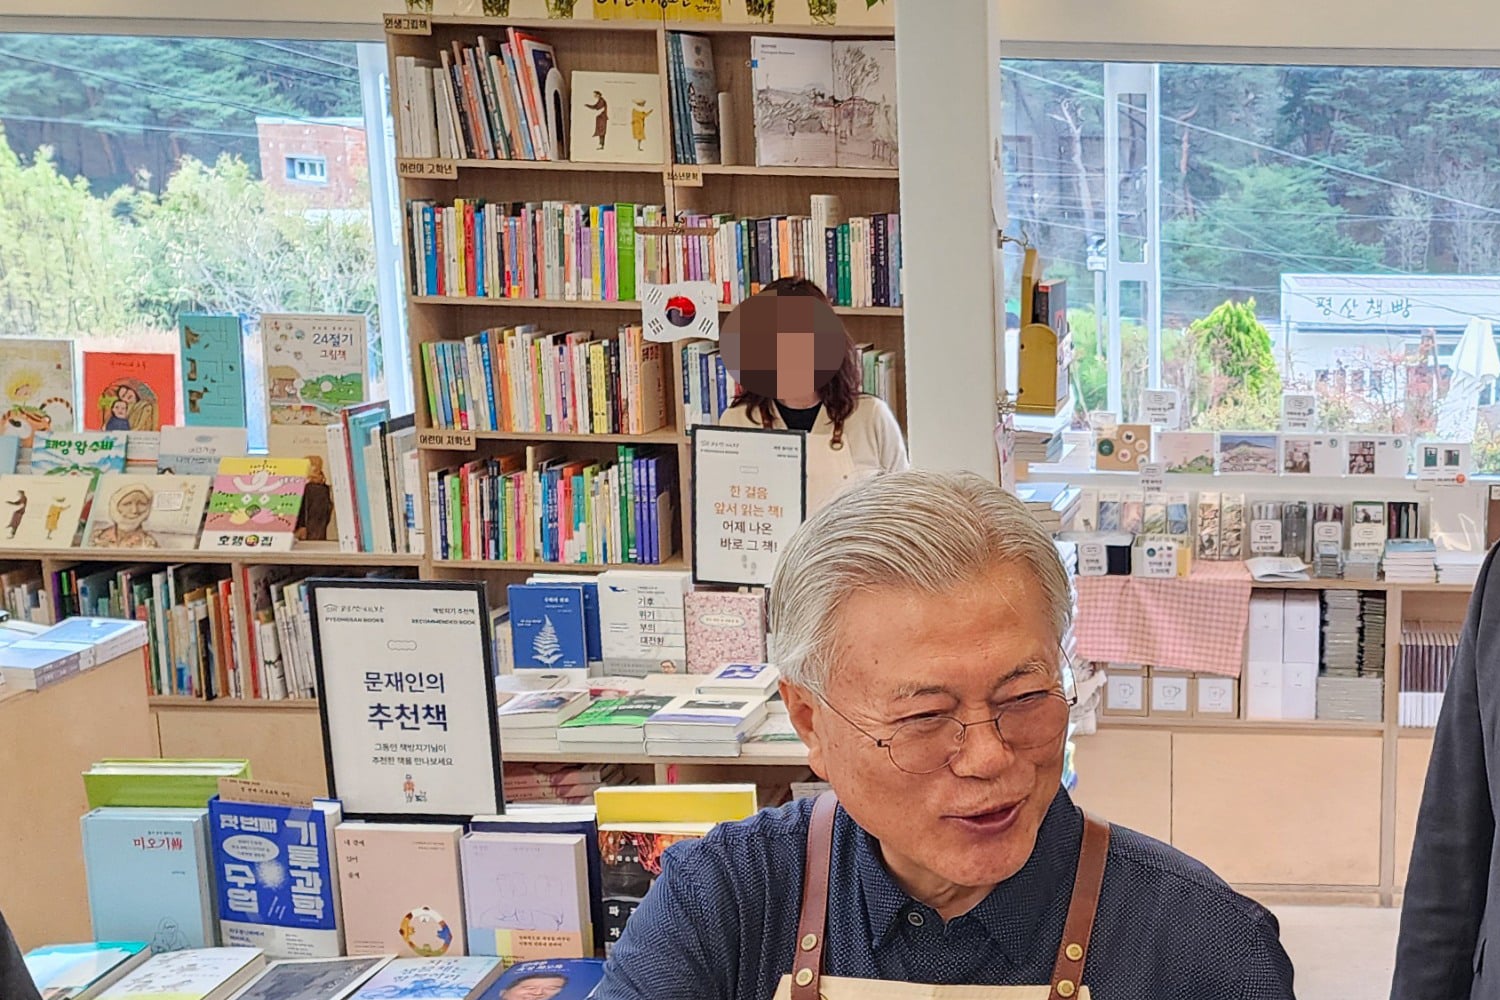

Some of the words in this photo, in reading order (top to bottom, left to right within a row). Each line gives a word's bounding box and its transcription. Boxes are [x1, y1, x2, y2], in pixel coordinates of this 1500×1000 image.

[385, 18, 428, 29] 인생그림책
[400, 163, 425, 174] 어린이
[428, 164, 452, 175] 고학년
[312, 333, 353, 346] 24절기
[319, 350, 347, 360] 그림책
[419, 433, 444, 447] 어린이
[730, 485, 740, 497] 한
[745, 486, 768, 499] 걸음
[714, 502, 737, 514] 앞서
[741, 504, 764, 517] 읽는
[768, 505, 783, 518] 책!
[723, 521, 745, 533] 어제
[749, 522, 772, 535] 나온
[720, 538, 744, 550] 바로
[747, 541, 758, 550] 그
[762, 541, 778, 552] 책!
[637, 597, 654, 606] 기후
[639, 610, 655, 619] 위기
[640, 624, 655, 632] 부의
[640, 637, 664, 645] 대전환
[364, 672, 444, 693] 문재인의
[368, 703, 448, 731] 추천책
[414, 757, 453, 766] 만나보세요
